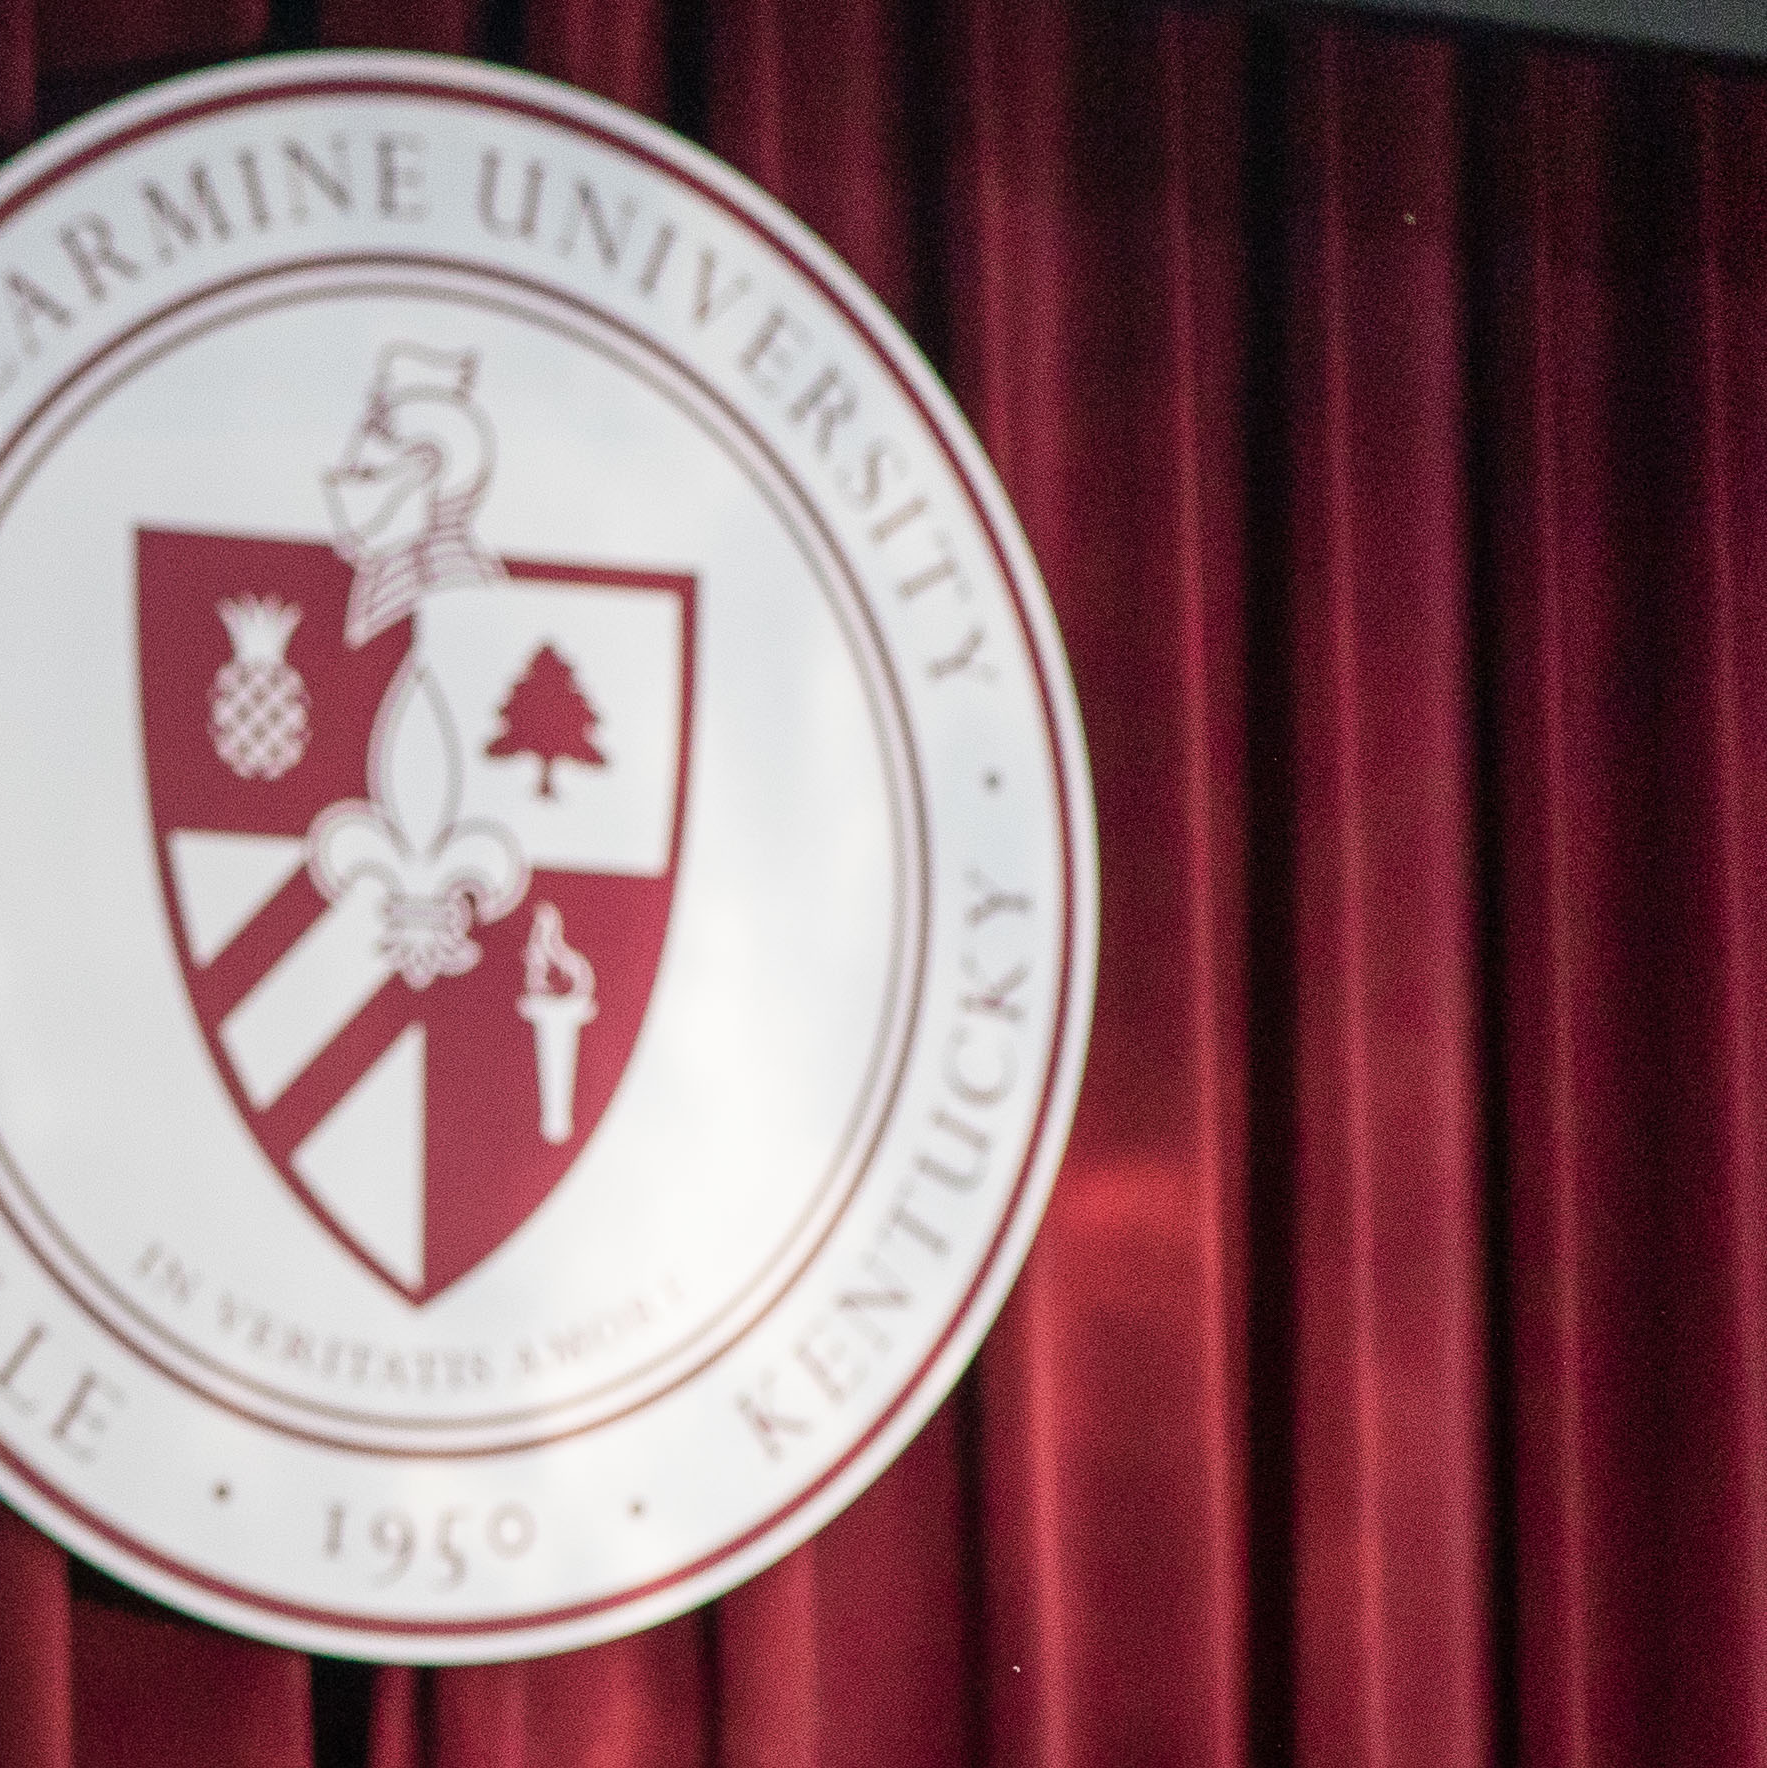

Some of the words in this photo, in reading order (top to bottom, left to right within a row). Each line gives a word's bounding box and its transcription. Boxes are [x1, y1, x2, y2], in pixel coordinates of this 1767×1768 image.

[475, 146, 999, 688] UNIVERSITY
[133, 1240, 205, 1304] IN
[735, 866, 1035, 1462] KENTUCKY
[321, 1500, 539, 1592] 1950
